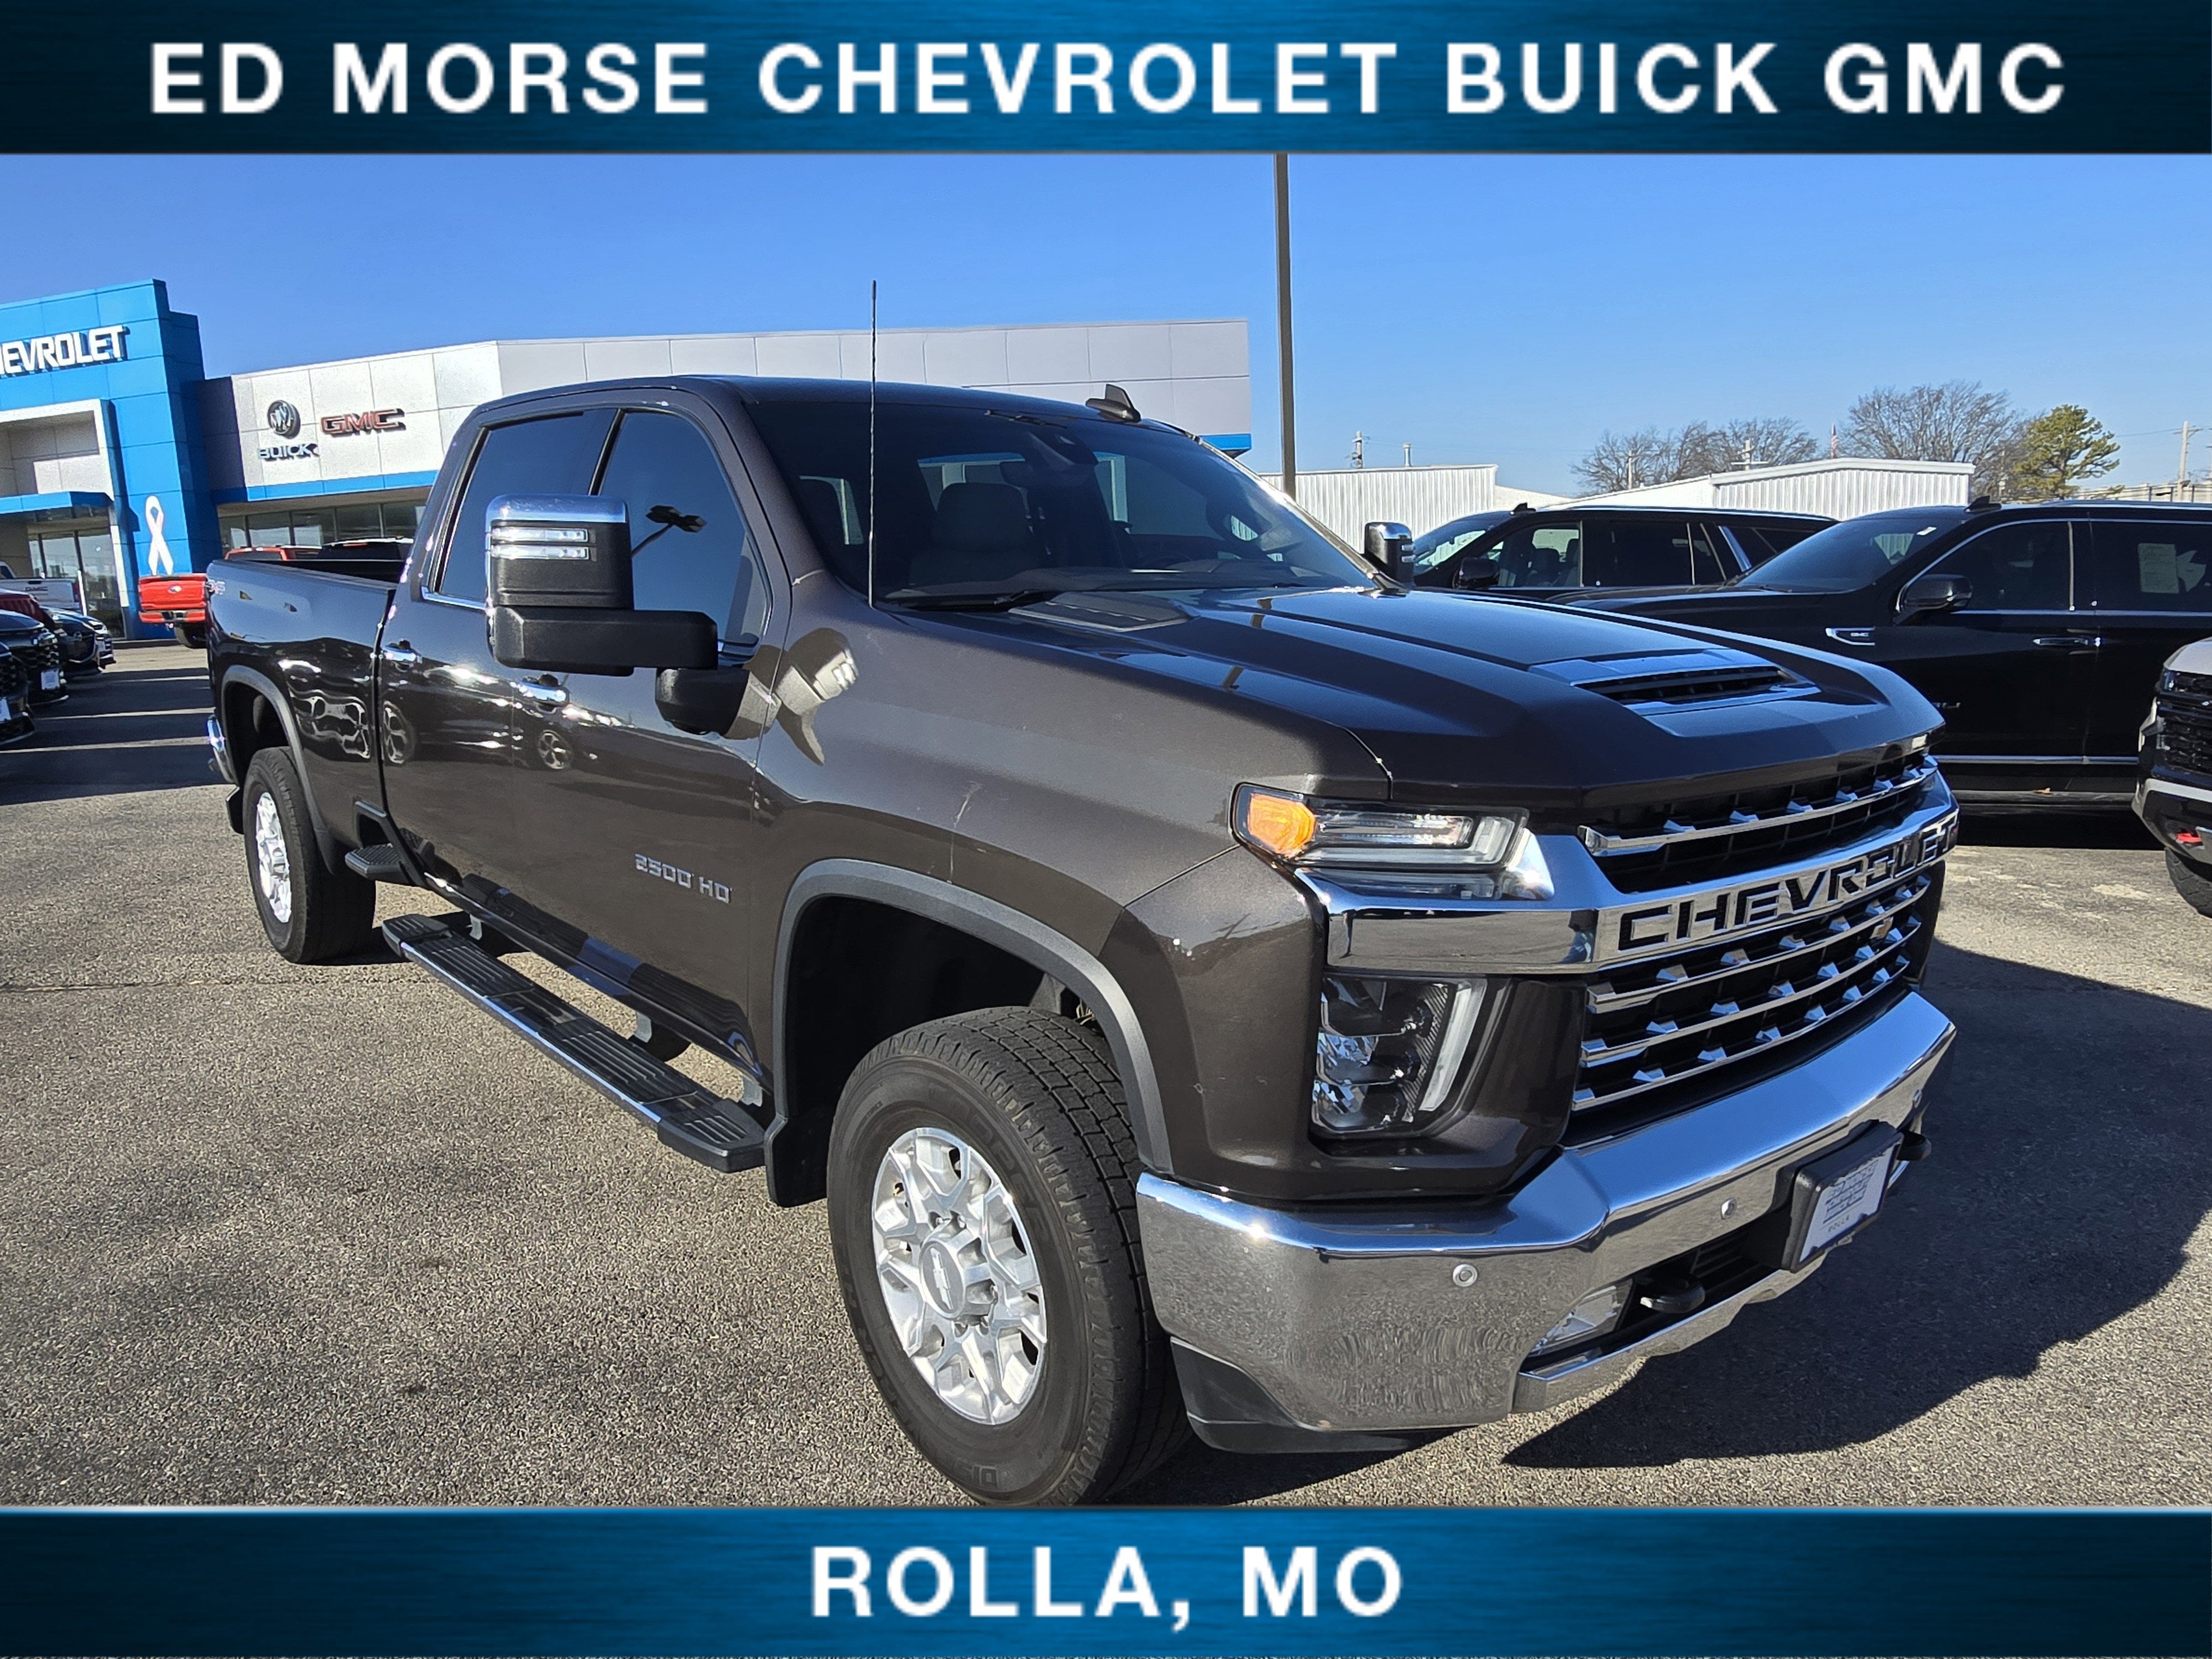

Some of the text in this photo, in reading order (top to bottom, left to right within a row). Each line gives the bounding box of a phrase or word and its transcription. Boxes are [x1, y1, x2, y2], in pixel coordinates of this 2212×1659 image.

[0, 325, 125, 375] EVROLET
[321, 409, 402, 435] GMC
[258, 444, 314, 459] BUICK
[635, 853, 730, 904] 2500 HD
[1618, 814, 1959, 953] CHEVROLET
